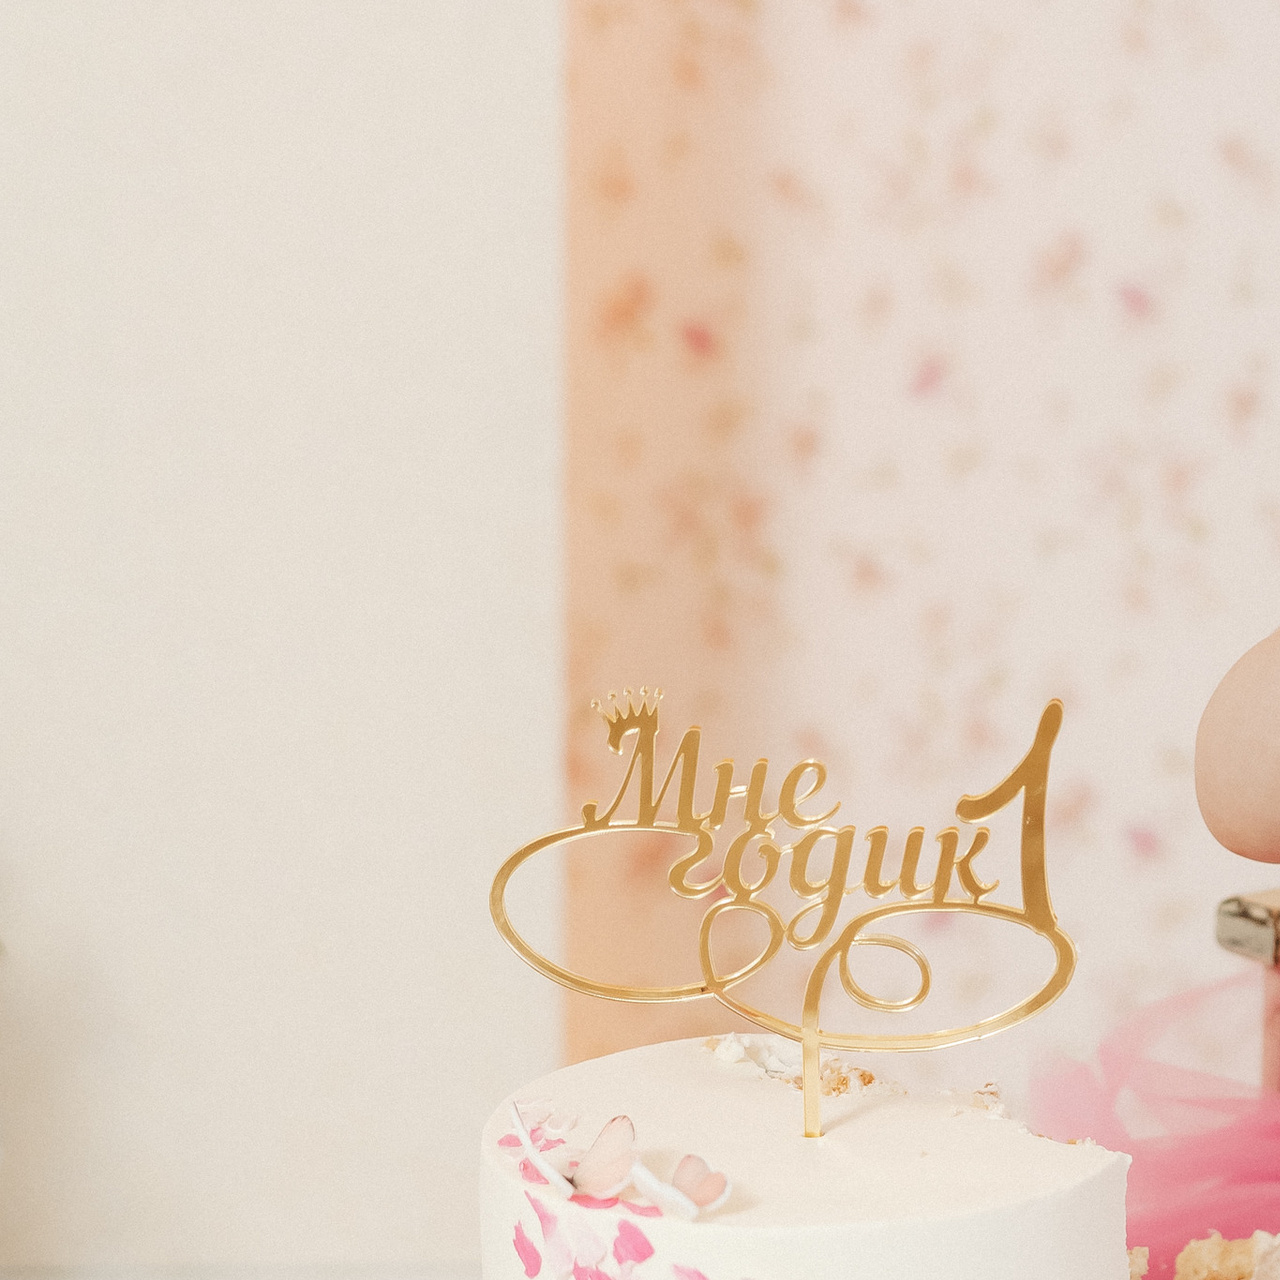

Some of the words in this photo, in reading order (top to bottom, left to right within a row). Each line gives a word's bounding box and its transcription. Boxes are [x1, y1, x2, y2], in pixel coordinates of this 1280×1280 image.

[581, 716, 842, 830] Мне
[667, 824, 1000, 951] годик
[955, 697, 1064, 928] 1
